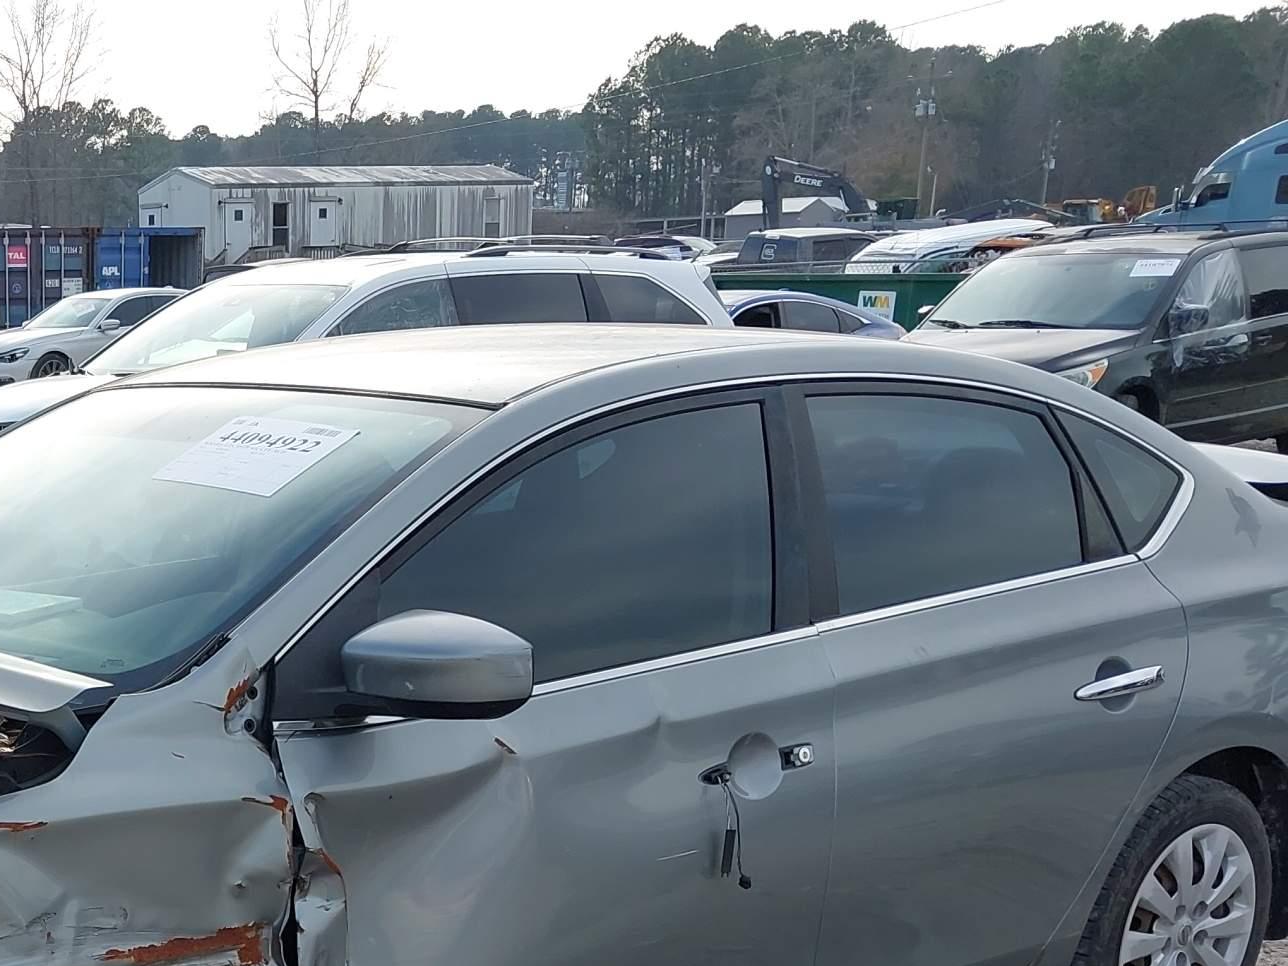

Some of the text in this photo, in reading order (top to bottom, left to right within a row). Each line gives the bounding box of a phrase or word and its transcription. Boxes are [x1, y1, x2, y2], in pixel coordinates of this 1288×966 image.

[794, 175, 823, 187] DEERE
[8, 252, 26, 260] TAL
[102, 266, 121, 276] APL
[863, 295, 889, 308] WM
[219, 430, 322, 453] 44094922
